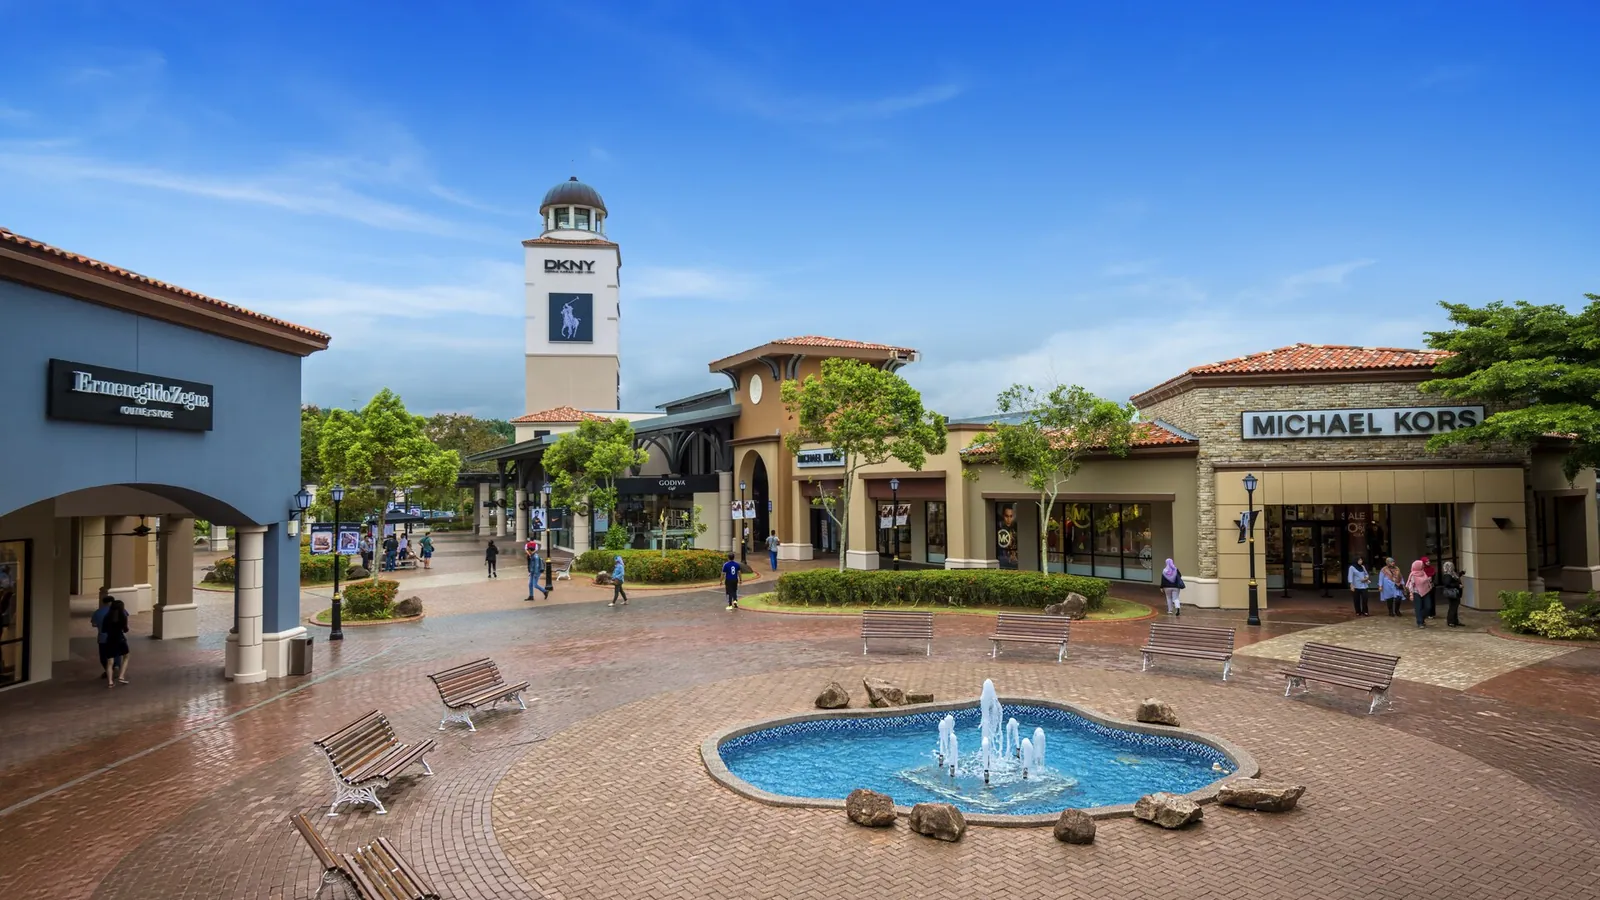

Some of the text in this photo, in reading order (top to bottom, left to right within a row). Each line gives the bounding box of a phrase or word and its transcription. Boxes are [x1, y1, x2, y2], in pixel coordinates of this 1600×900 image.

[544, 259, 595, 270] DKNY
[72, 370, 209, 410] Ermenegildo Zegna
[151, 409, 173, 418] STORE
[1253, 410, 1477, 436] MICHAEL KORS
[731, 566, 735, 575] 8
